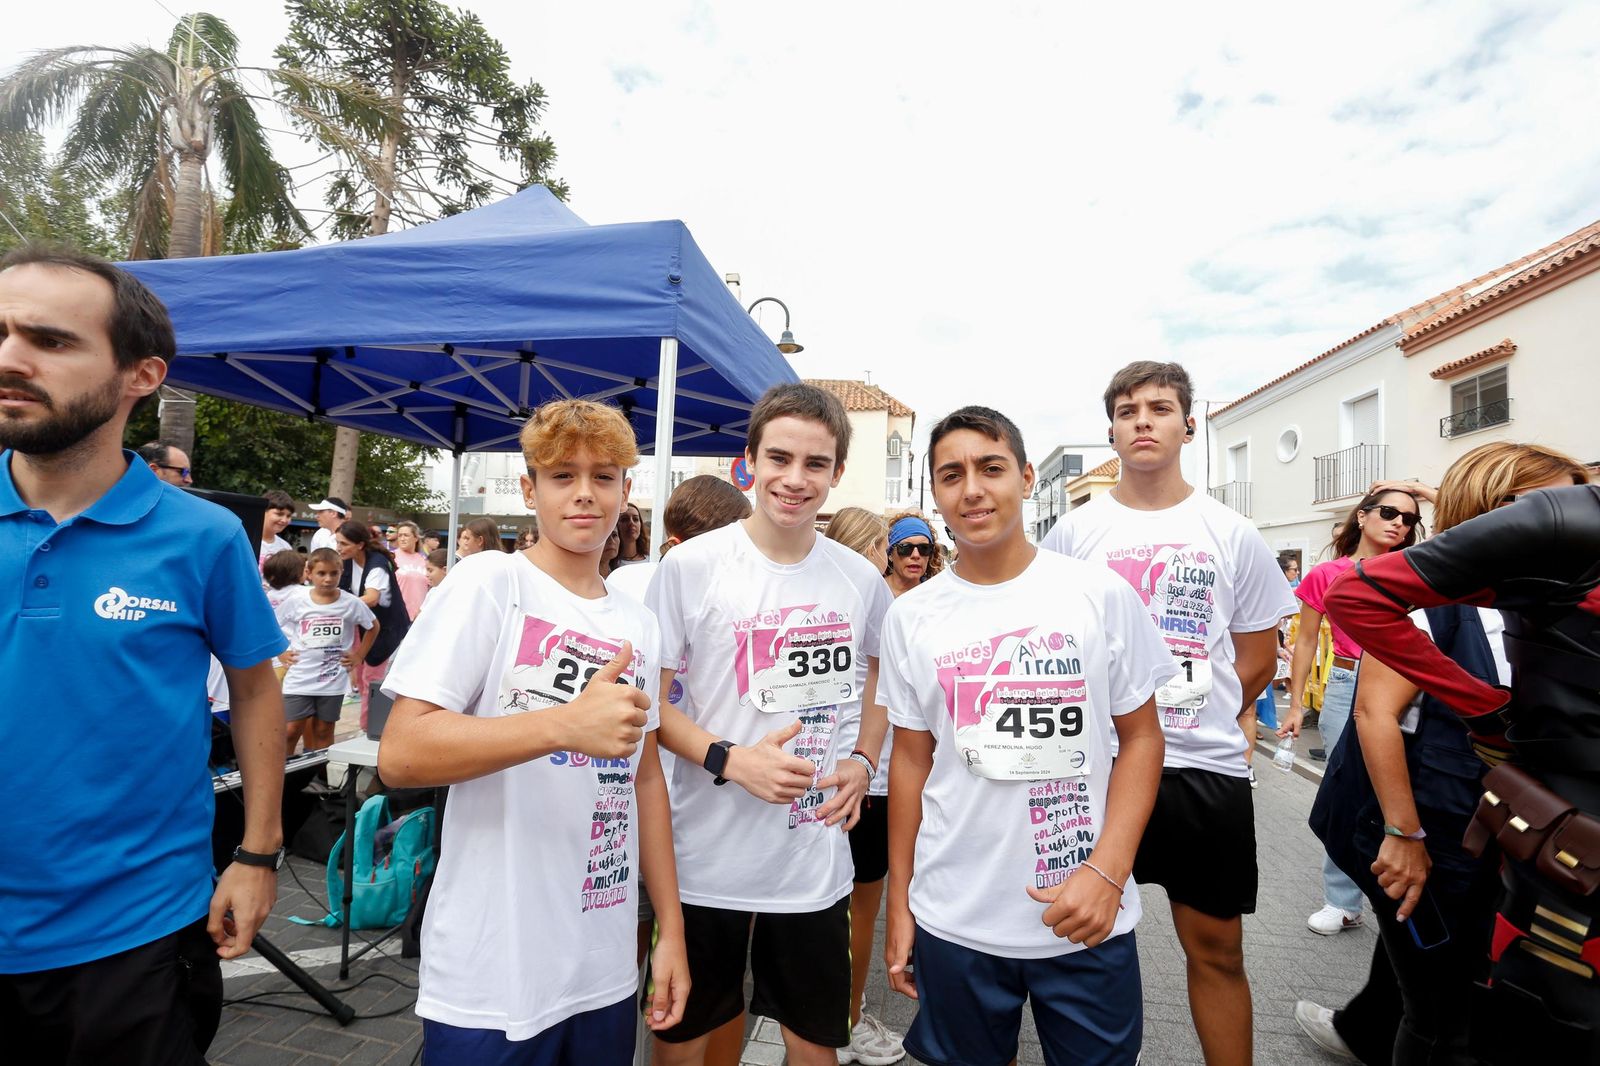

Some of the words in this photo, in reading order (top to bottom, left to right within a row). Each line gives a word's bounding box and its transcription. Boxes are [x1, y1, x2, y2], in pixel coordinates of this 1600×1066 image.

[1106, 547, 1152, 559] valores
[1172, 551, 1215, 566] AMOR
[1168, 566, 1215, 587] ALEGRIA
[109, 586, 178, 614] DORSAL
[1167, 595, 1213, 613] FUERZA
[1166, 609, 1212, 623] HUMILDAD
[313, 626, 341, 636] 290
[934, 645, 991, 668] valores
[1018, 632, 1077, 663] AMOR
[788, 646, 852, 678] 330
[996, 706, 1084, 739] 459
[1030, 803, 1090, 825] Deporte
[1034, 815, 1093, 841] COLABORAR
